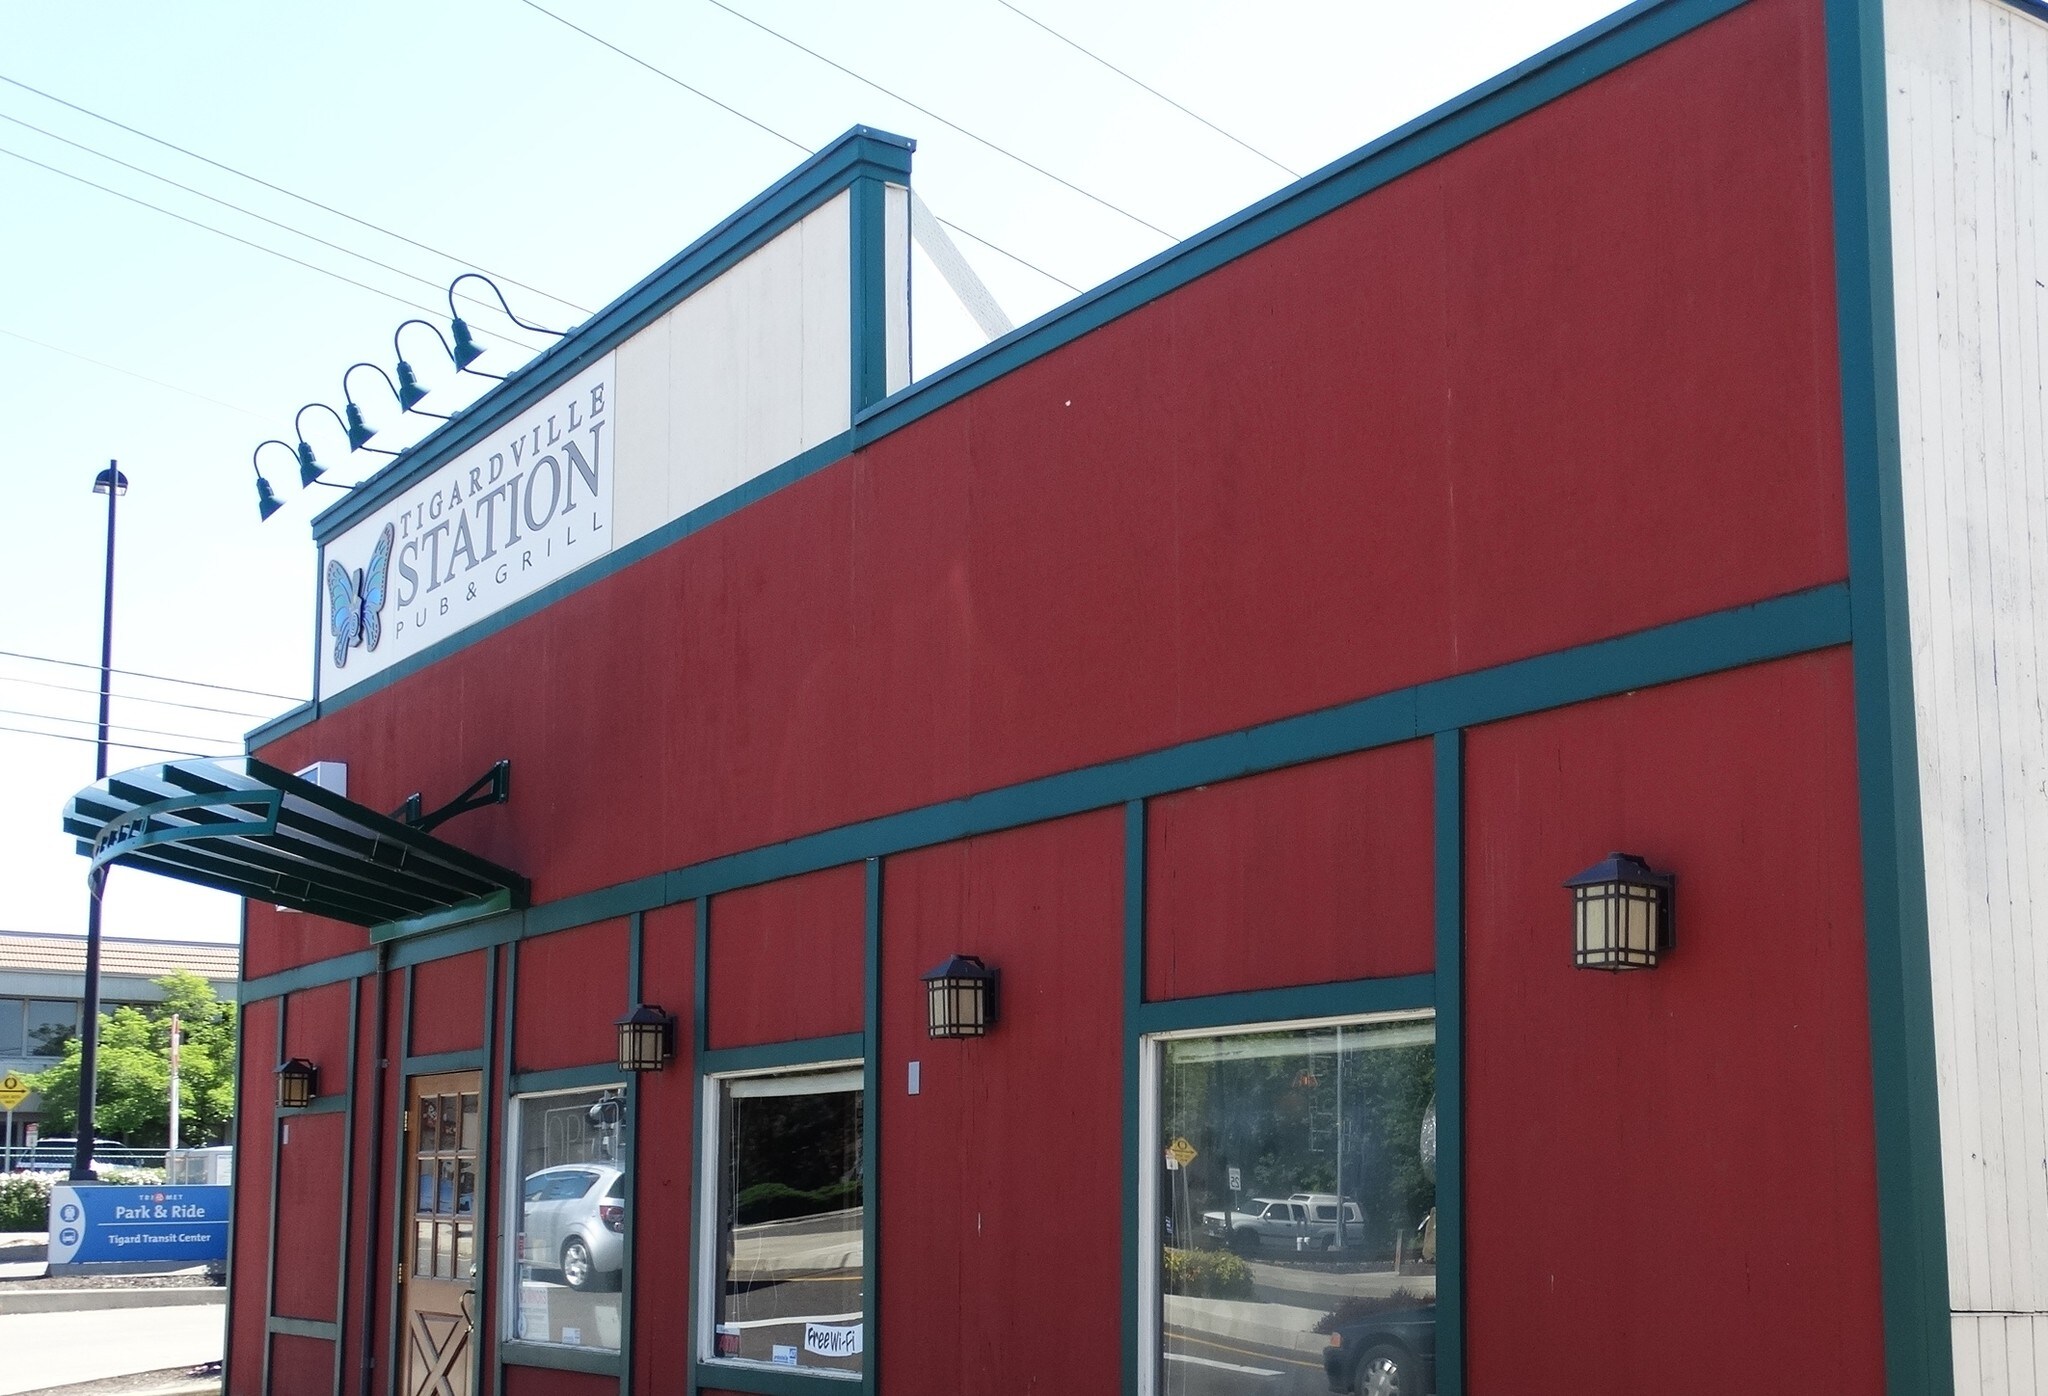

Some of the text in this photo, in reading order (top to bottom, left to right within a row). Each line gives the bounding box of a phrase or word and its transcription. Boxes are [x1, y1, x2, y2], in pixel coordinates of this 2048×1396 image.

[397, 420, 605, 612] STATION
[400, 382, 605, 539] TIGARDVILLE
[396, 511, 603, 640] PUB & GRILL
[108, 1233, 212, 1247] Tigard Transit Center
[116, 1204, 206, 1219] Park & Ride
